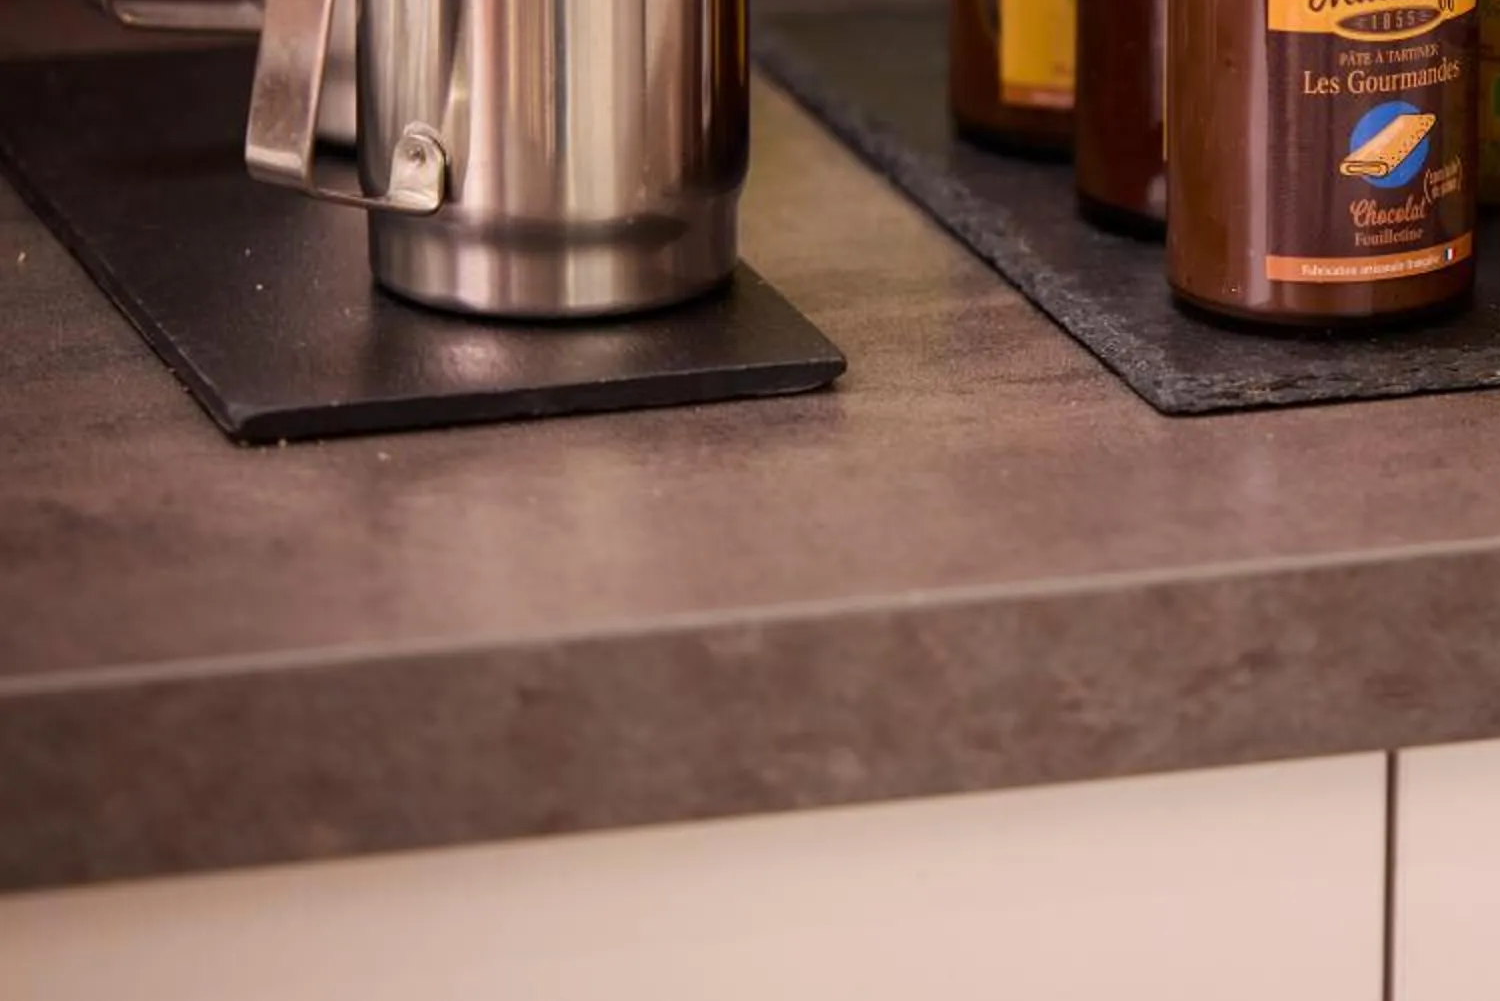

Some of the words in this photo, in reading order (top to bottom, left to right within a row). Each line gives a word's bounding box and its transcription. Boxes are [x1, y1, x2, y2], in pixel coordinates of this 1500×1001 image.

[1371, 10, 1417, 30] 1855
[1303, 70, 1341, 95] Les
[1347, 56, 1461, 95] Gourmandes
[1350, 194, 1427, 228] Chocolat
